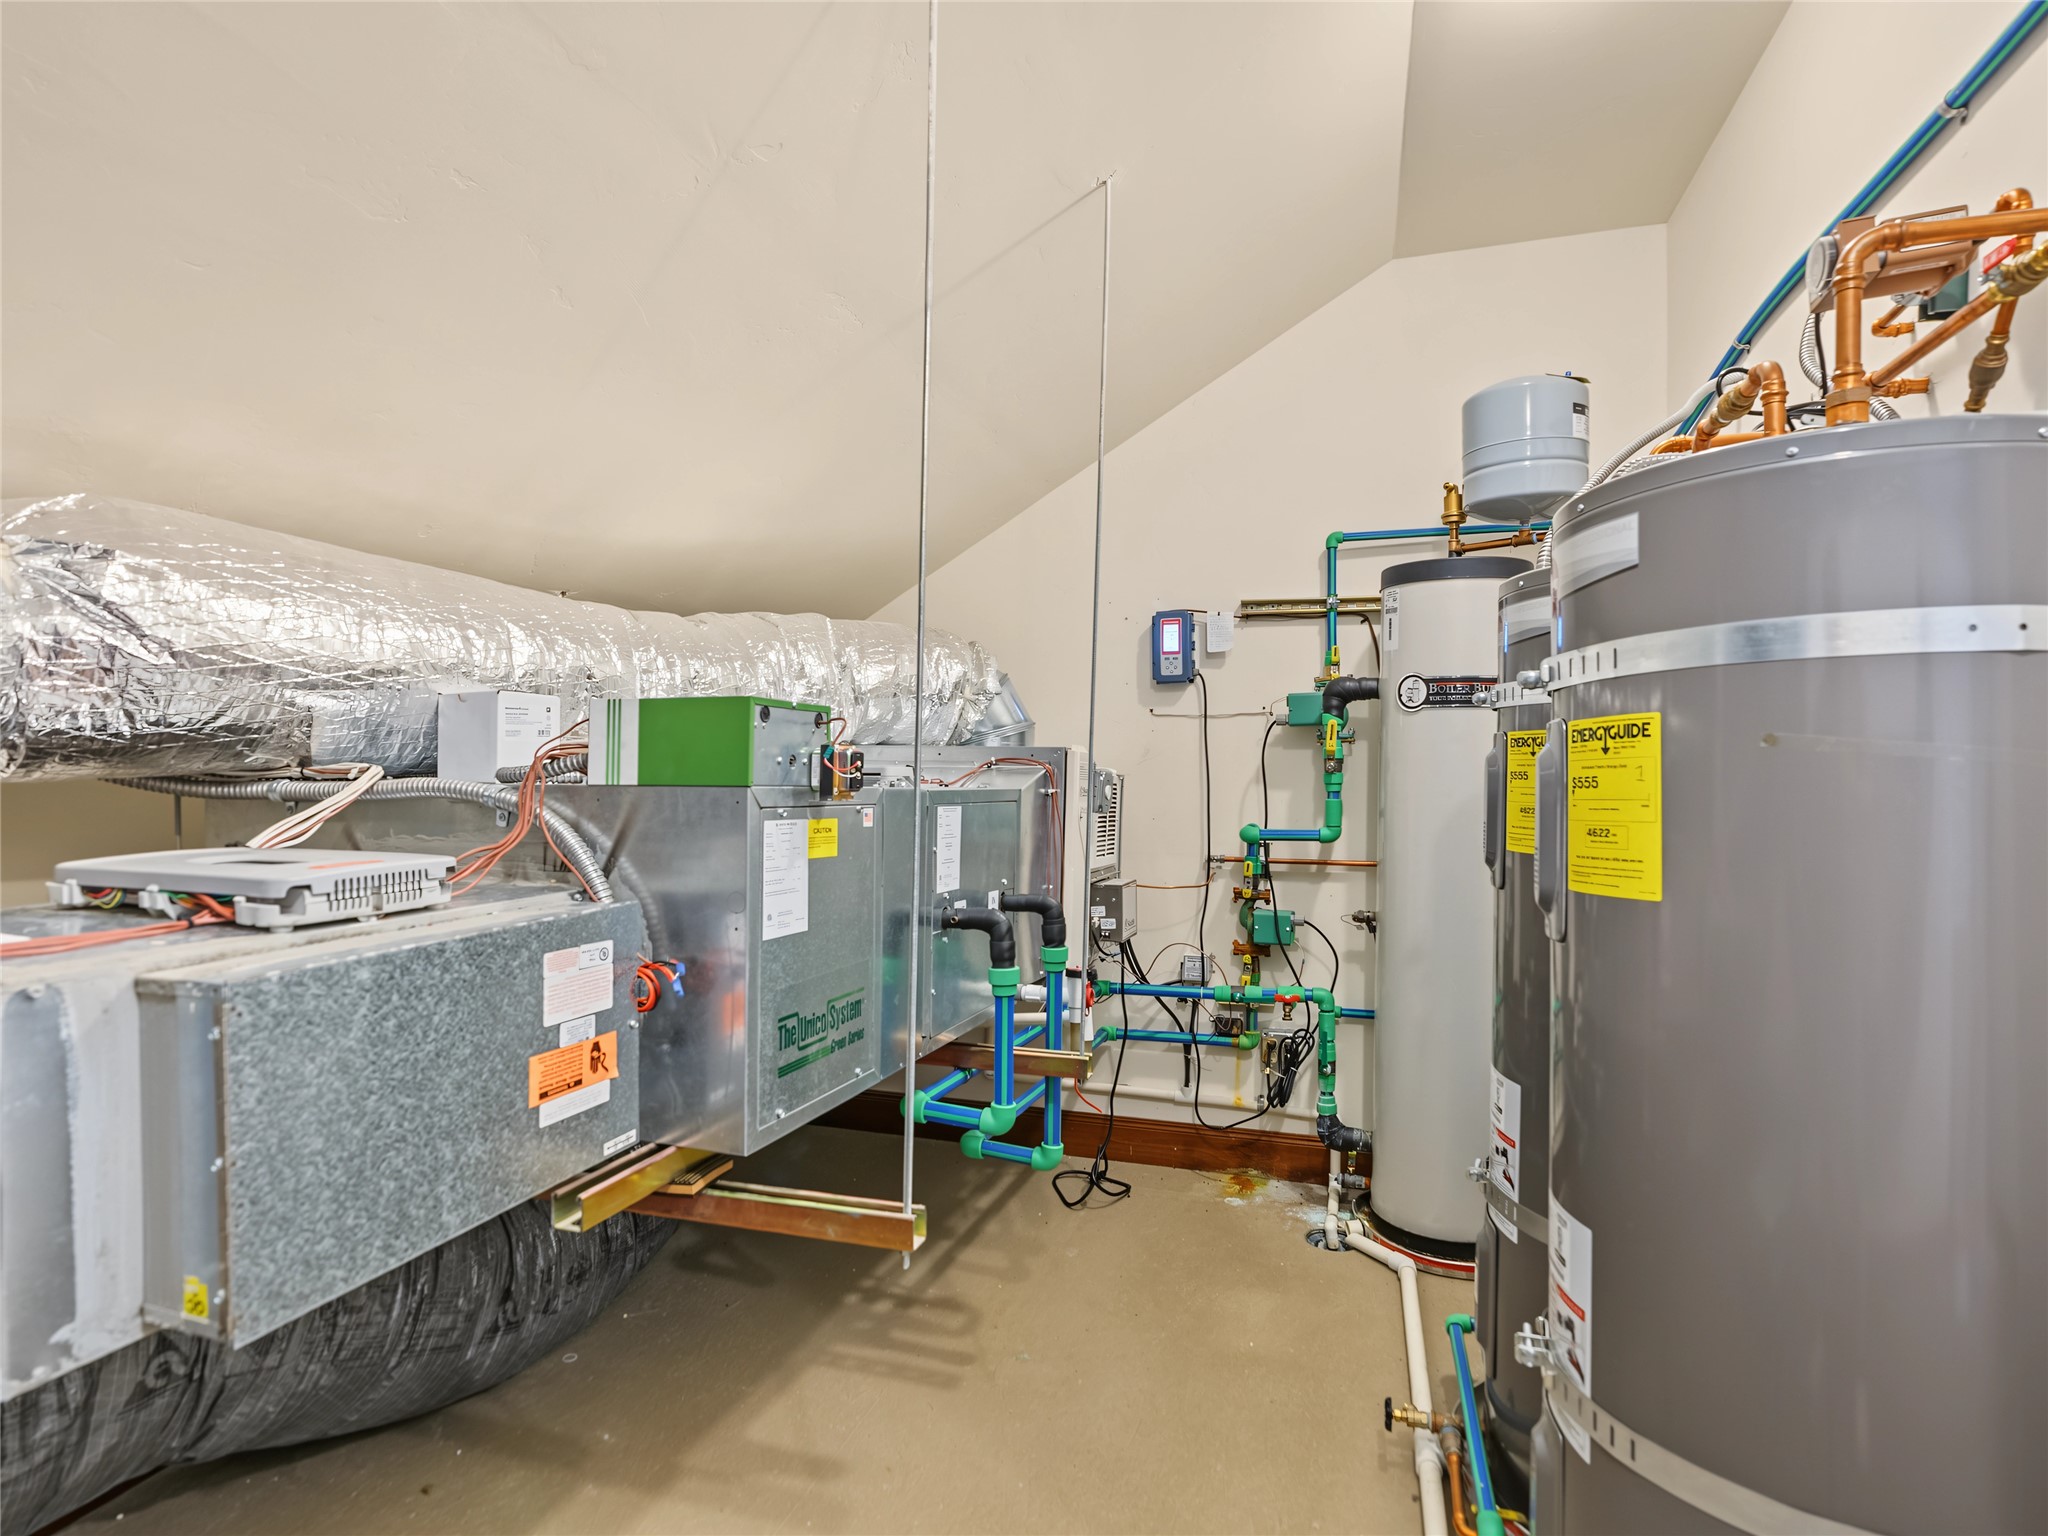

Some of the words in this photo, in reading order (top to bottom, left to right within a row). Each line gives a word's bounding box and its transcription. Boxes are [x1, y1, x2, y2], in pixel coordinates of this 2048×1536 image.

[1571, 722, 1651, 744] ENERGYGUIDE
[1510, 735, 1547, 749] ENERGYGU
[1571, 775, 1599, 789] $555
[1586, 828, 1610, 838] 4622
[778, 1023, 796, 1051] The
[800, 1012, 826, 1042] Unico
[829, 999, 862, 1031] System
